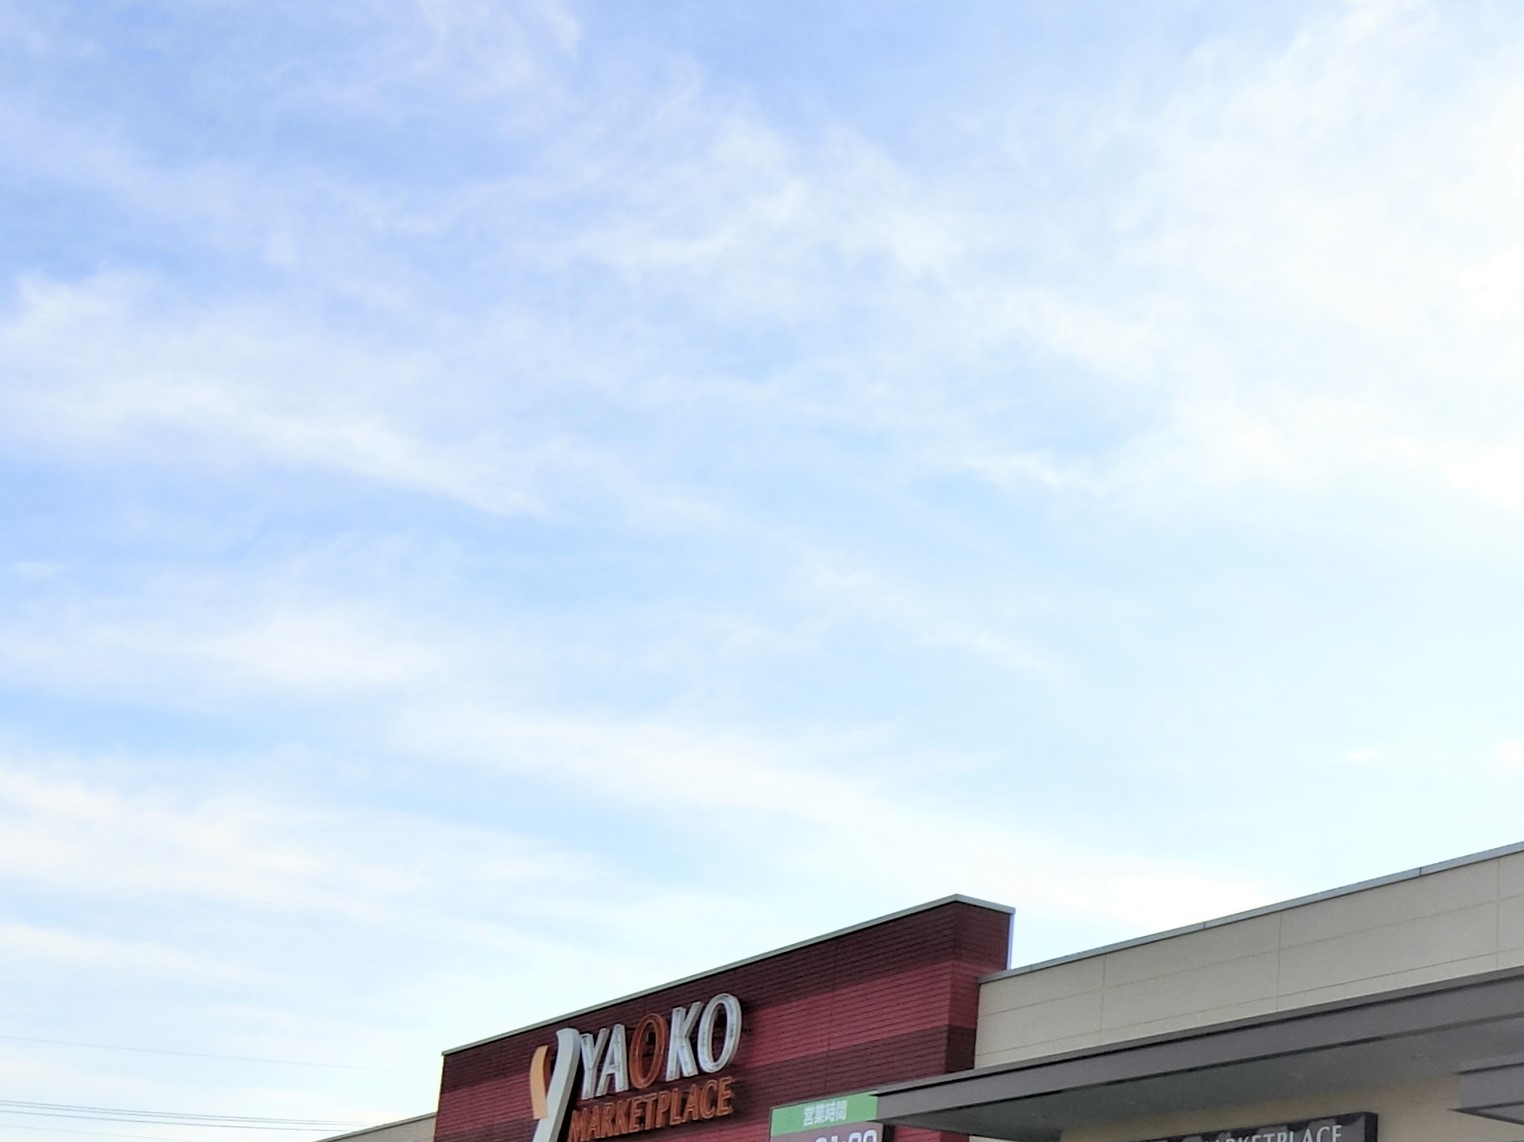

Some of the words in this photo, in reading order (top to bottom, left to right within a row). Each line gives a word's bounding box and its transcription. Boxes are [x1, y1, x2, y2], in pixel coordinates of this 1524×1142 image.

[580, 993, 742, 1100] YAOKO
[803, 1099, 848, 1126] 営業時間
